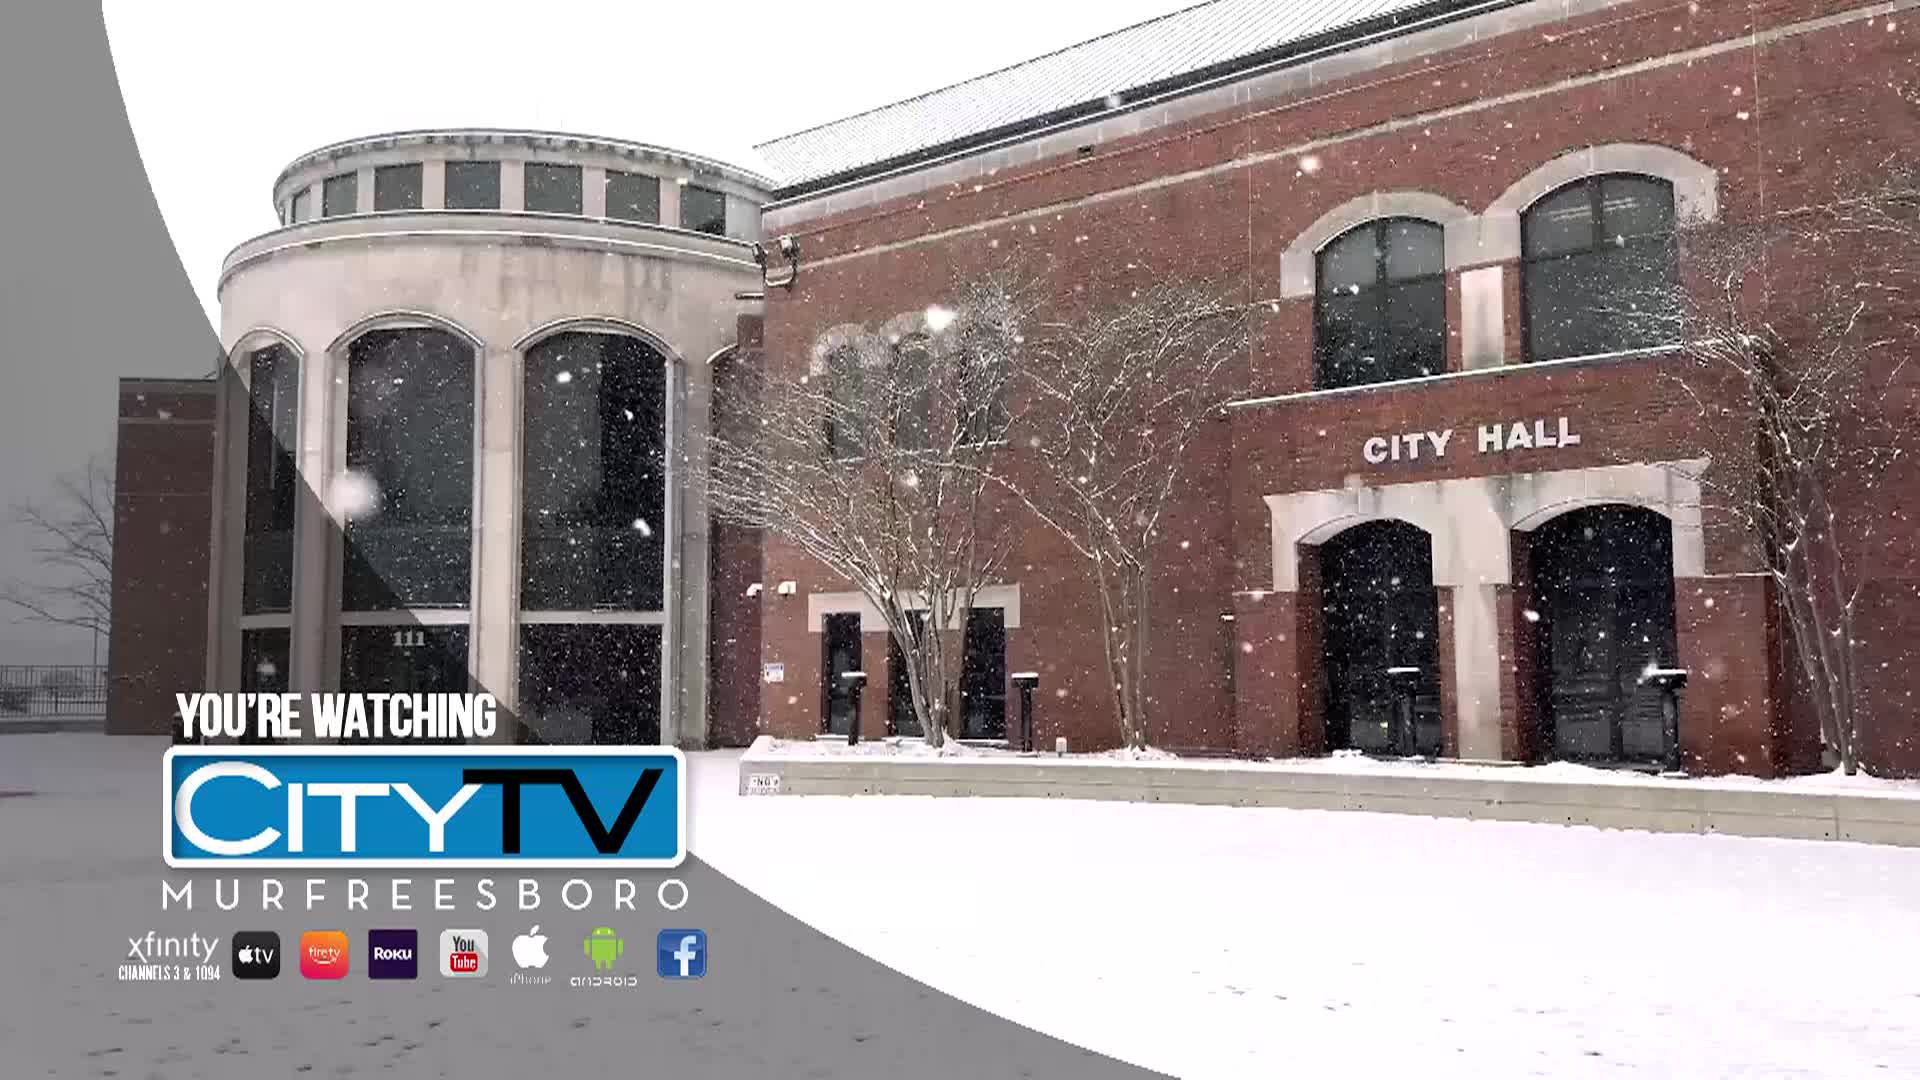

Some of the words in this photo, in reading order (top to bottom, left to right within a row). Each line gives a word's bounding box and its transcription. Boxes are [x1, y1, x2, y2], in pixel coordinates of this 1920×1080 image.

[1363, 429, 1453, 464] CITY
[1478, 417, 1581, 453] HALL
[392, 631, 426, 647] 111
